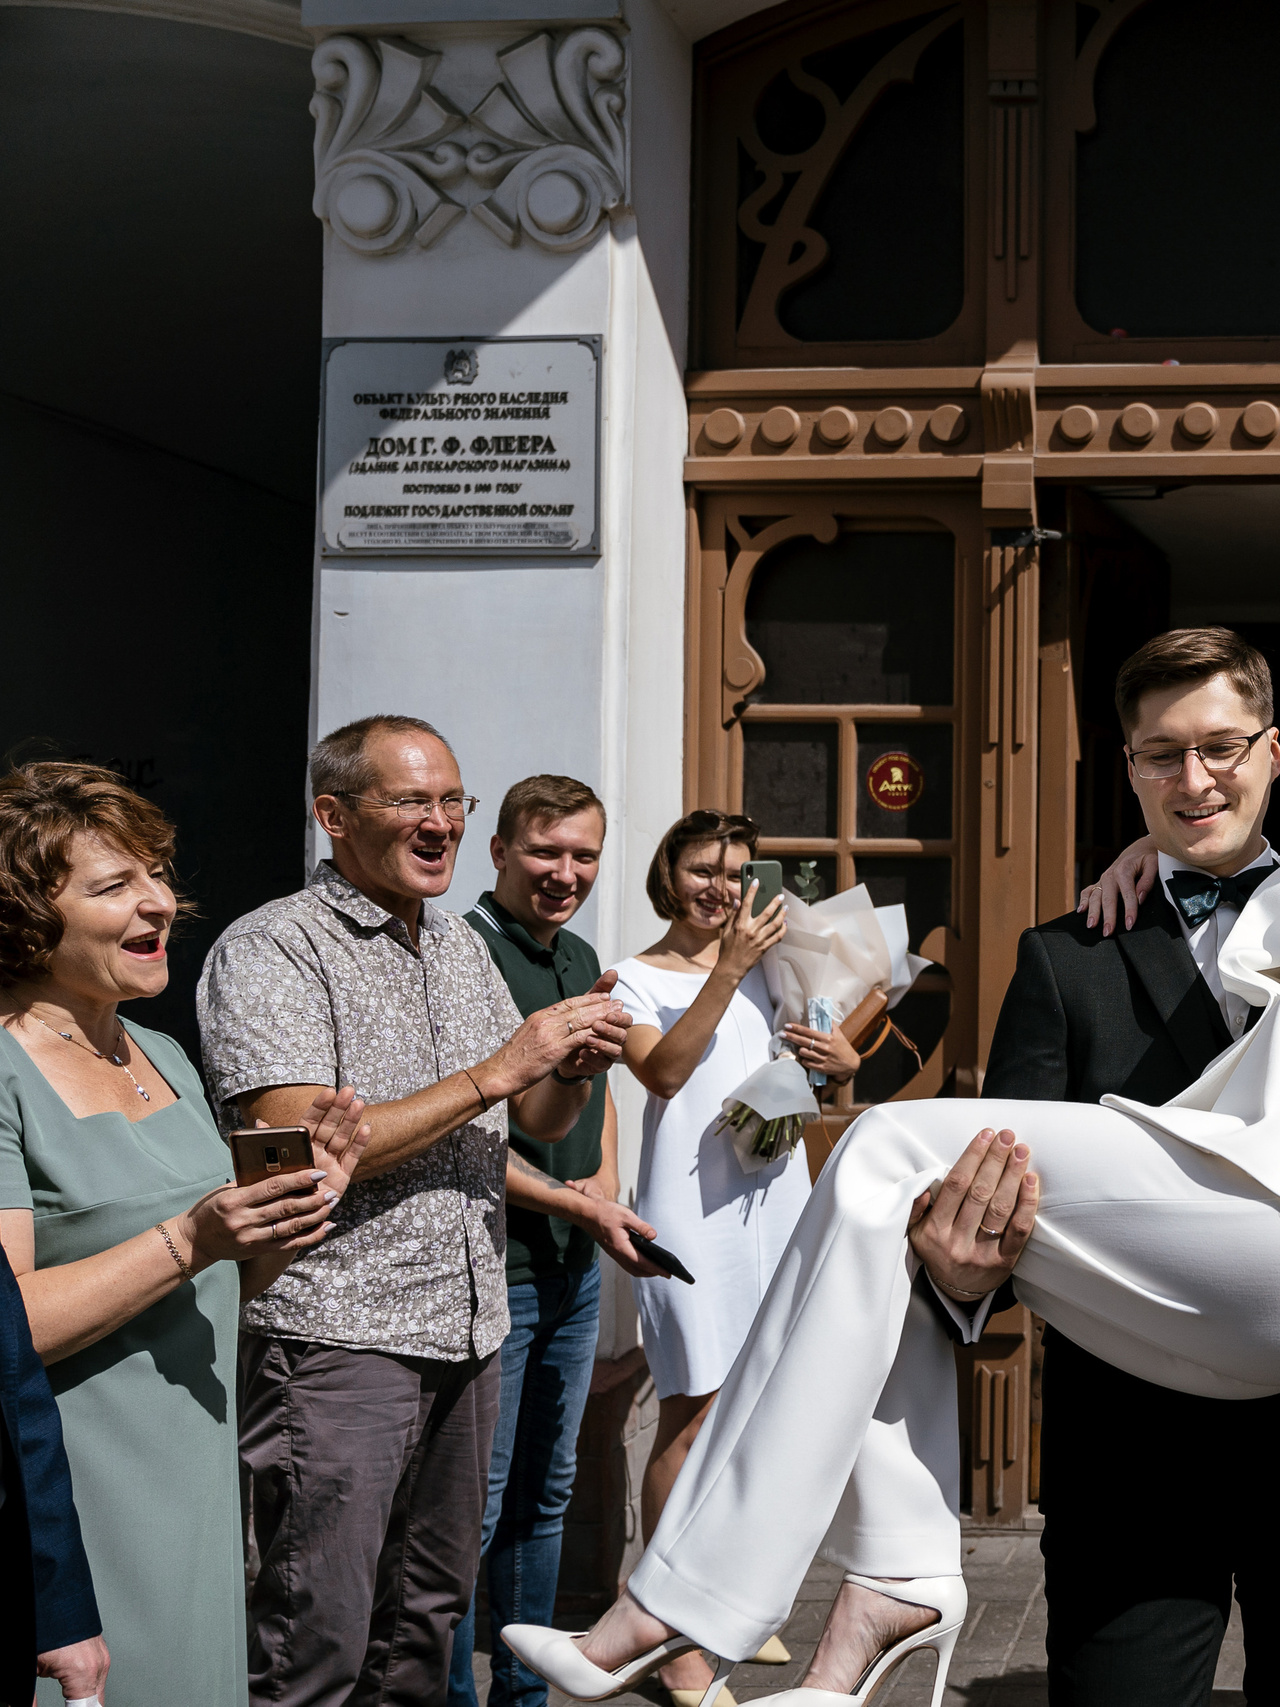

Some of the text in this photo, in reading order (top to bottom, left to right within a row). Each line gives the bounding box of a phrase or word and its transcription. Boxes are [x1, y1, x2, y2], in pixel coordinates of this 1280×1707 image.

[353, 393, 404, 405] ОБЪЕКТ
[499, 391, 569, 406] НАСЛЕДИЯ
[379, 407, 550, 421] ФЕДЕРАЛЬНОГО ЗНАЧЕНИЯ
[364, 435, 557, 459] ДОМ Г. Ф. ФЛЕЕРА
[402, 460, 498, 473] АПТЕКАРСКОГО
[501, 459, 571, 473] МАГАЗИНА)
[403, 484, 461, 495] ПОСТРОЕНО
[464, 483, 471, 494] В
[495, 483, 522, 495] ГОДУ
[344, 505, 410, 518] ПОДЛЕЖИТ
[411, 502, 528, 518] ГОСУДАРСТВЕННОЙ
